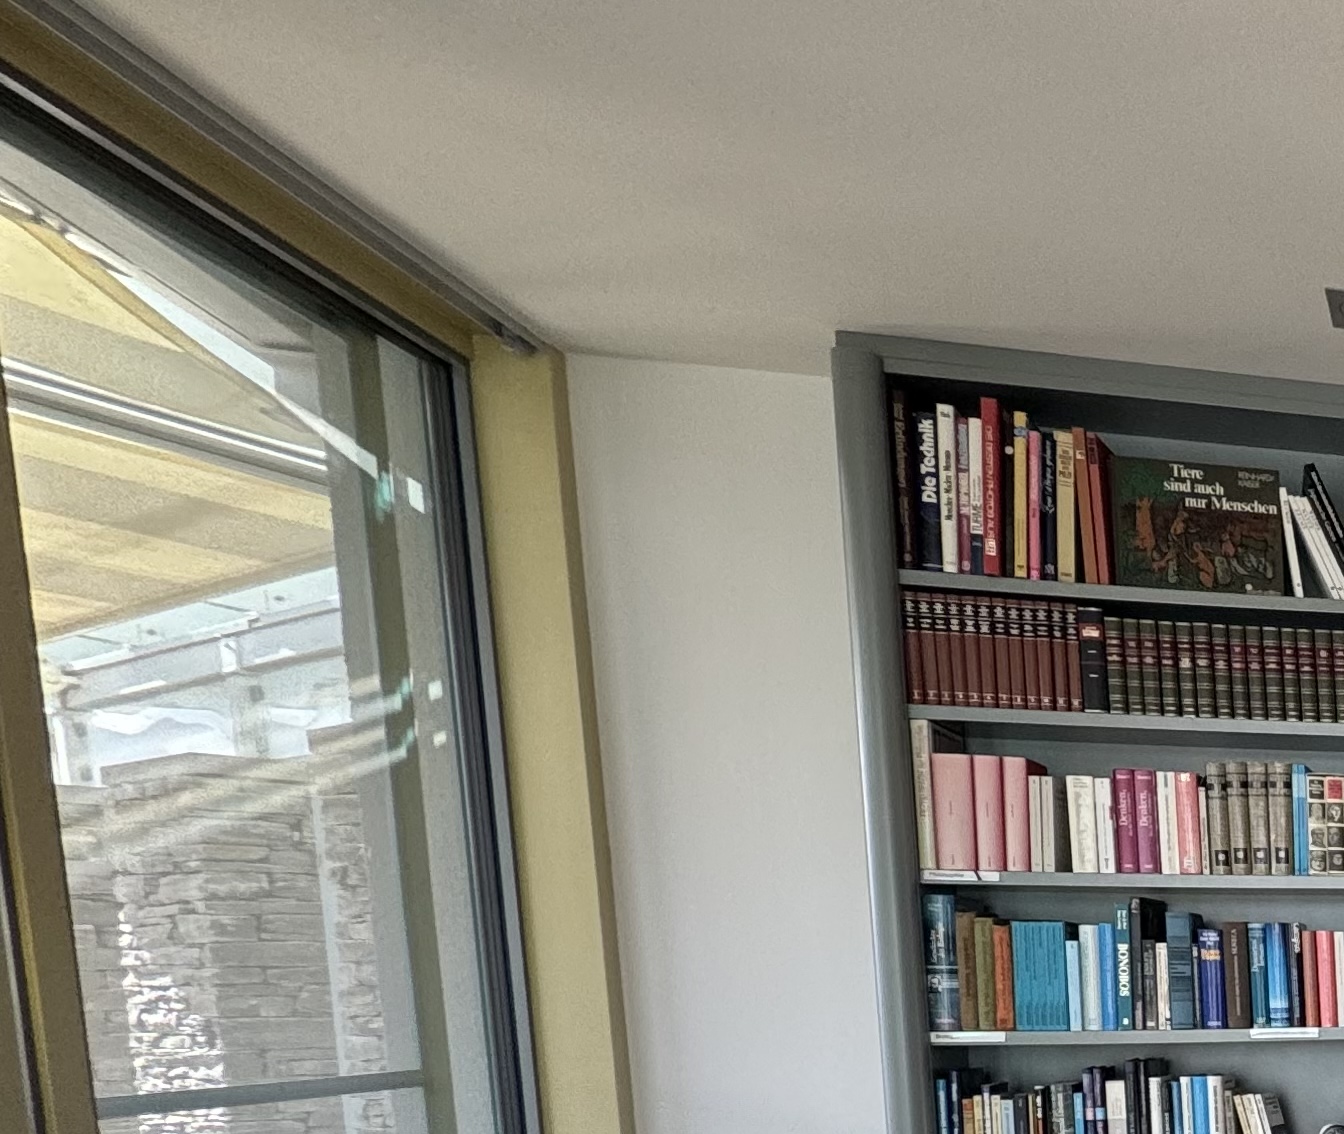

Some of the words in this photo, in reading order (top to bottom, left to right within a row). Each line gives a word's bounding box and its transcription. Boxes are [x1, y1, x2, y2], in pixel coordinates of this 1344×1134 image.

[918, 419, 936, 474] Technik
[1169, 463, 1204, 479] Tiere
[922, 476, 938, 503] Die
[1163, 477, 1191, 493] sind
[1194, 482, 1224, 496] auch
[1185, 497, 1208, 509] nur
[1211, 496, 1277, 515] Menschen
[1117, 943, 1130, 997] BONOBOS
